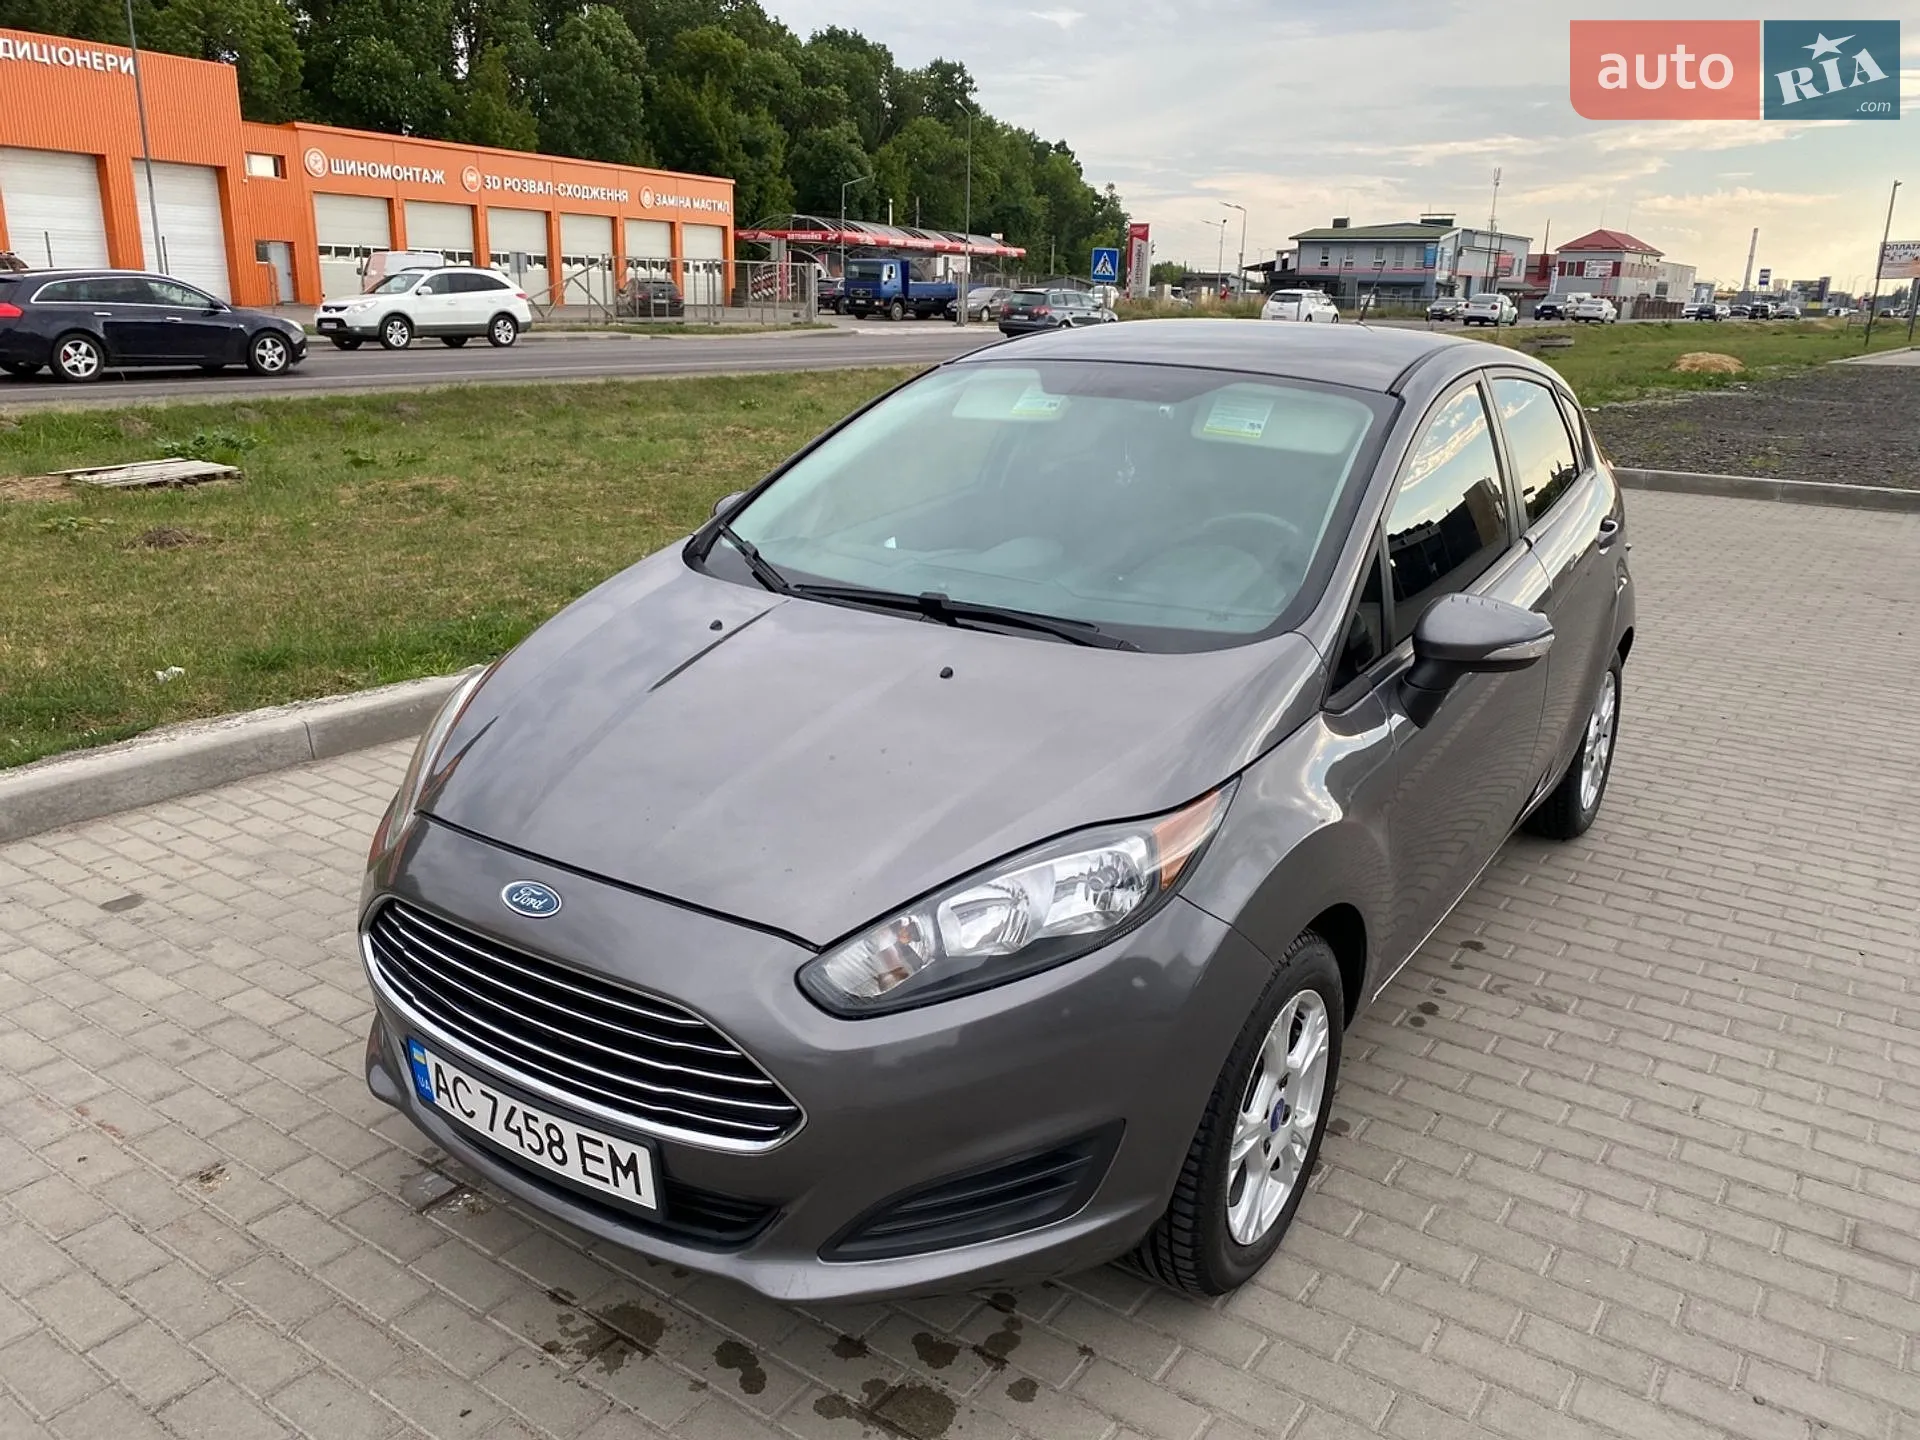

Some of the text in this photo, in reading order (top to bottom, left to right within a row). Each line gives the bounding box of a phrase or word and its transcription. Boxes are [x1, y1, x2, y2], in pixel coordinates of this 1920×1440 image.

[329, 158, 446, 185] ШИНОМОНТАЖ
[483, 175, 501, 190] 3D
[654, 193, 731, 214] ЗАМІНА МАСТИЛ
[512, 886, 548, 910] Ford
[434, 1062, 642, 1197] AC 7458 EM
